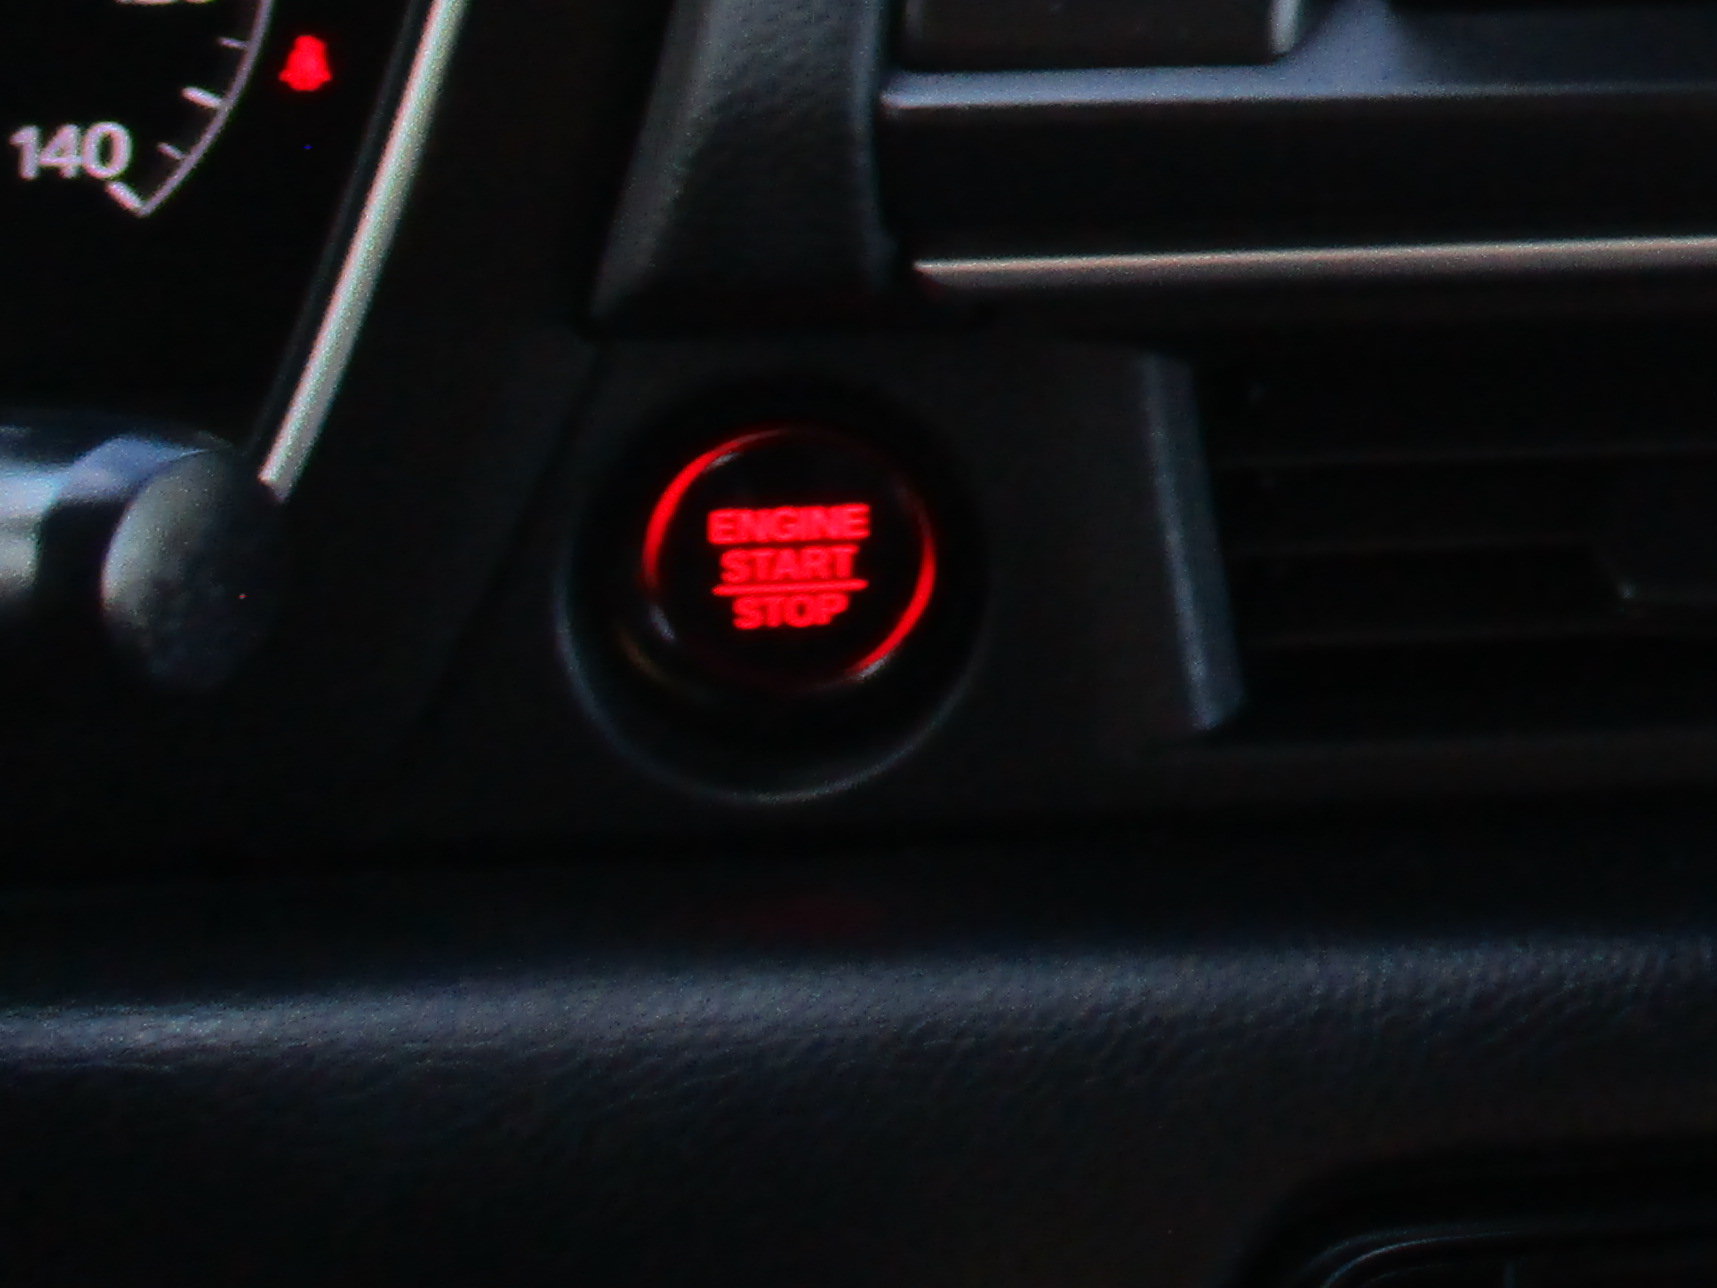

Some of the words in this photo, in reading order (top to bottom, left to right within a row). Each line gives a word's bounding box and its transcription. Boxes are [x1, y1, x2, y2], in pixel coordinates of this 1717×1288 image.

[11, 122, 133, 180] 140
[707, 503, 870, 545] ENGINE
[720, 545, 859, 584] START
[732, 592, 848, 630] STOP
